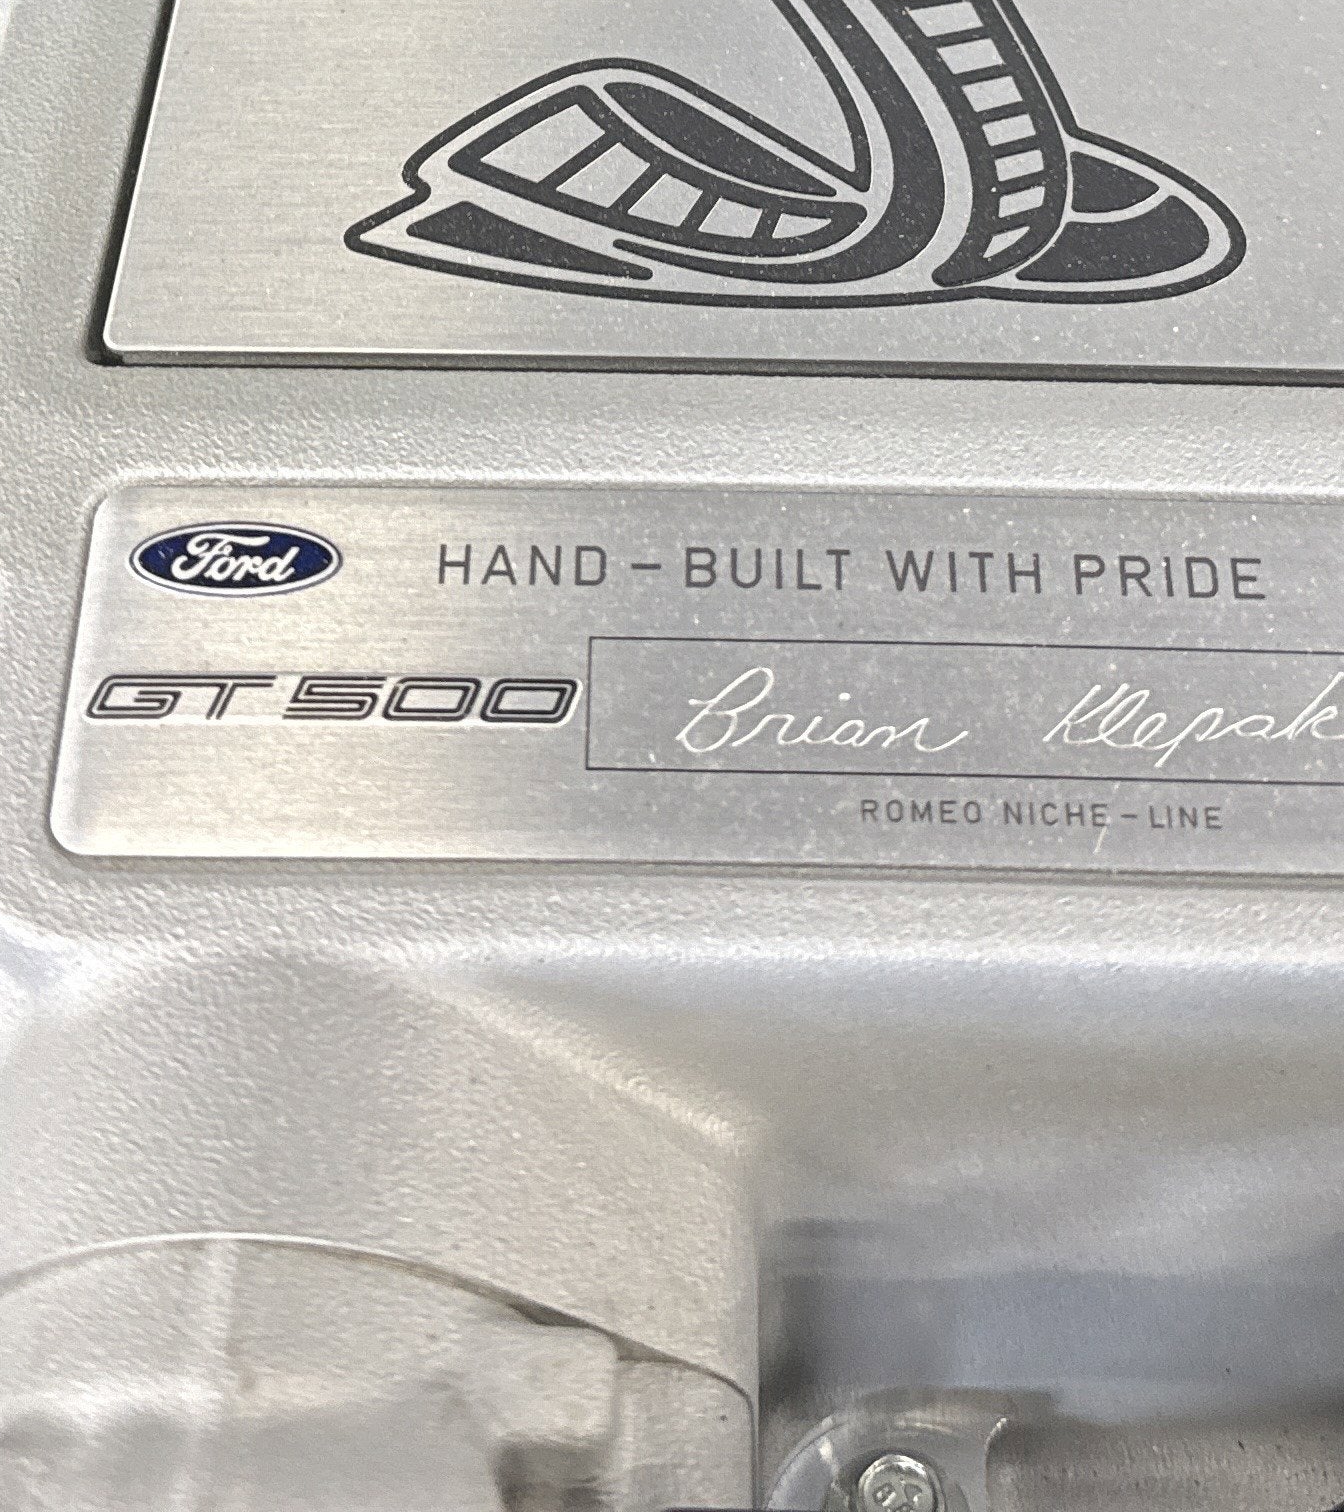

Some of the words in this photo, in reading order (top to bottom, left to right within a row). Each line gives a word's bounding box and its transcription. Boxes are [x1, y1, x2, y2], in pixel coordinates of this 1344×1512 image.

[170, 531, 298, 584] Ford
[886, 550, 1043, 595] WITH
[1074, 553, 1266, 600] PRIDE
[675, 666, 969, 753] Brian
[860, 799, 982, 825] ROMEO
